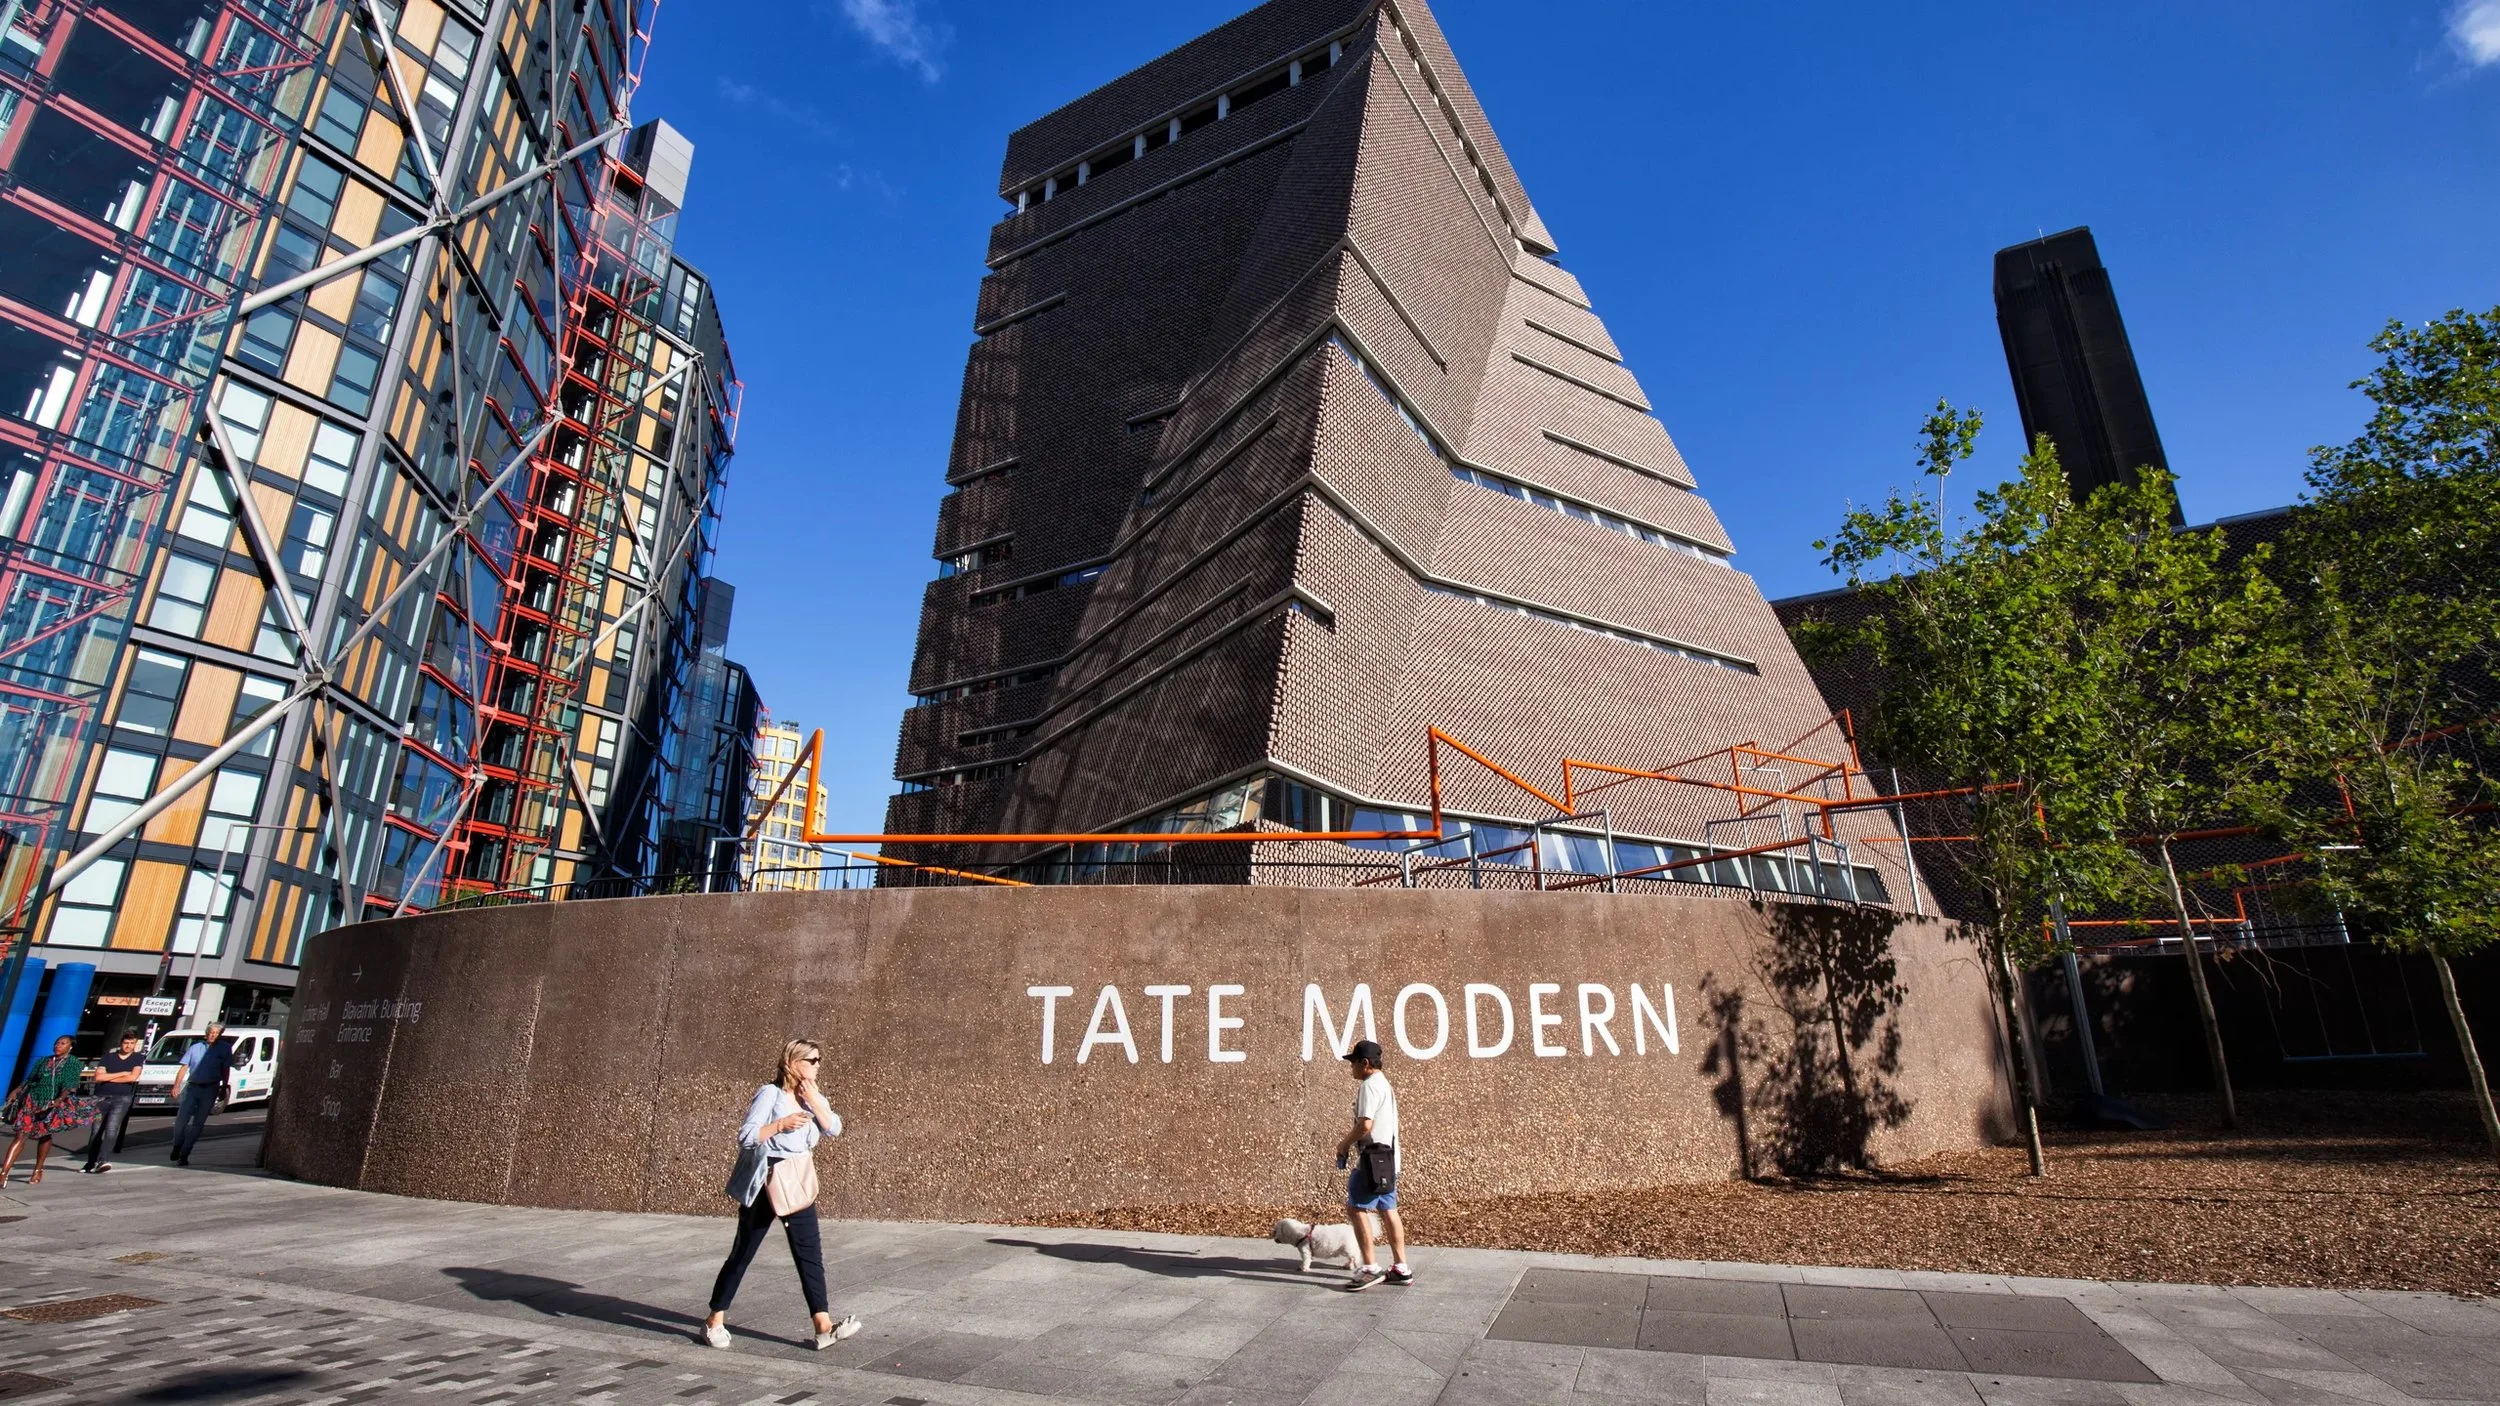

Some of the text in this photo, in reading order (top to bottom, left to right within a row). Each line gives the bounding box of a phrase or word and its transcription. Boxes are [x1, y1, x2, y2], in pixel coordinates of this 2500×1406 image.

[144, 1006, 169, 1014] cycles
[145, 999, 172, 1007] Except
[342, 999, 422, 1024] Blavatnik Building
[1026, 982, 1680, 1064] TATE MODERN
[337, 1024, 372, 1043] Entrance
[329, 1059, 343, 1079] Bar
[320, 1095, 342, 1122] Shop
